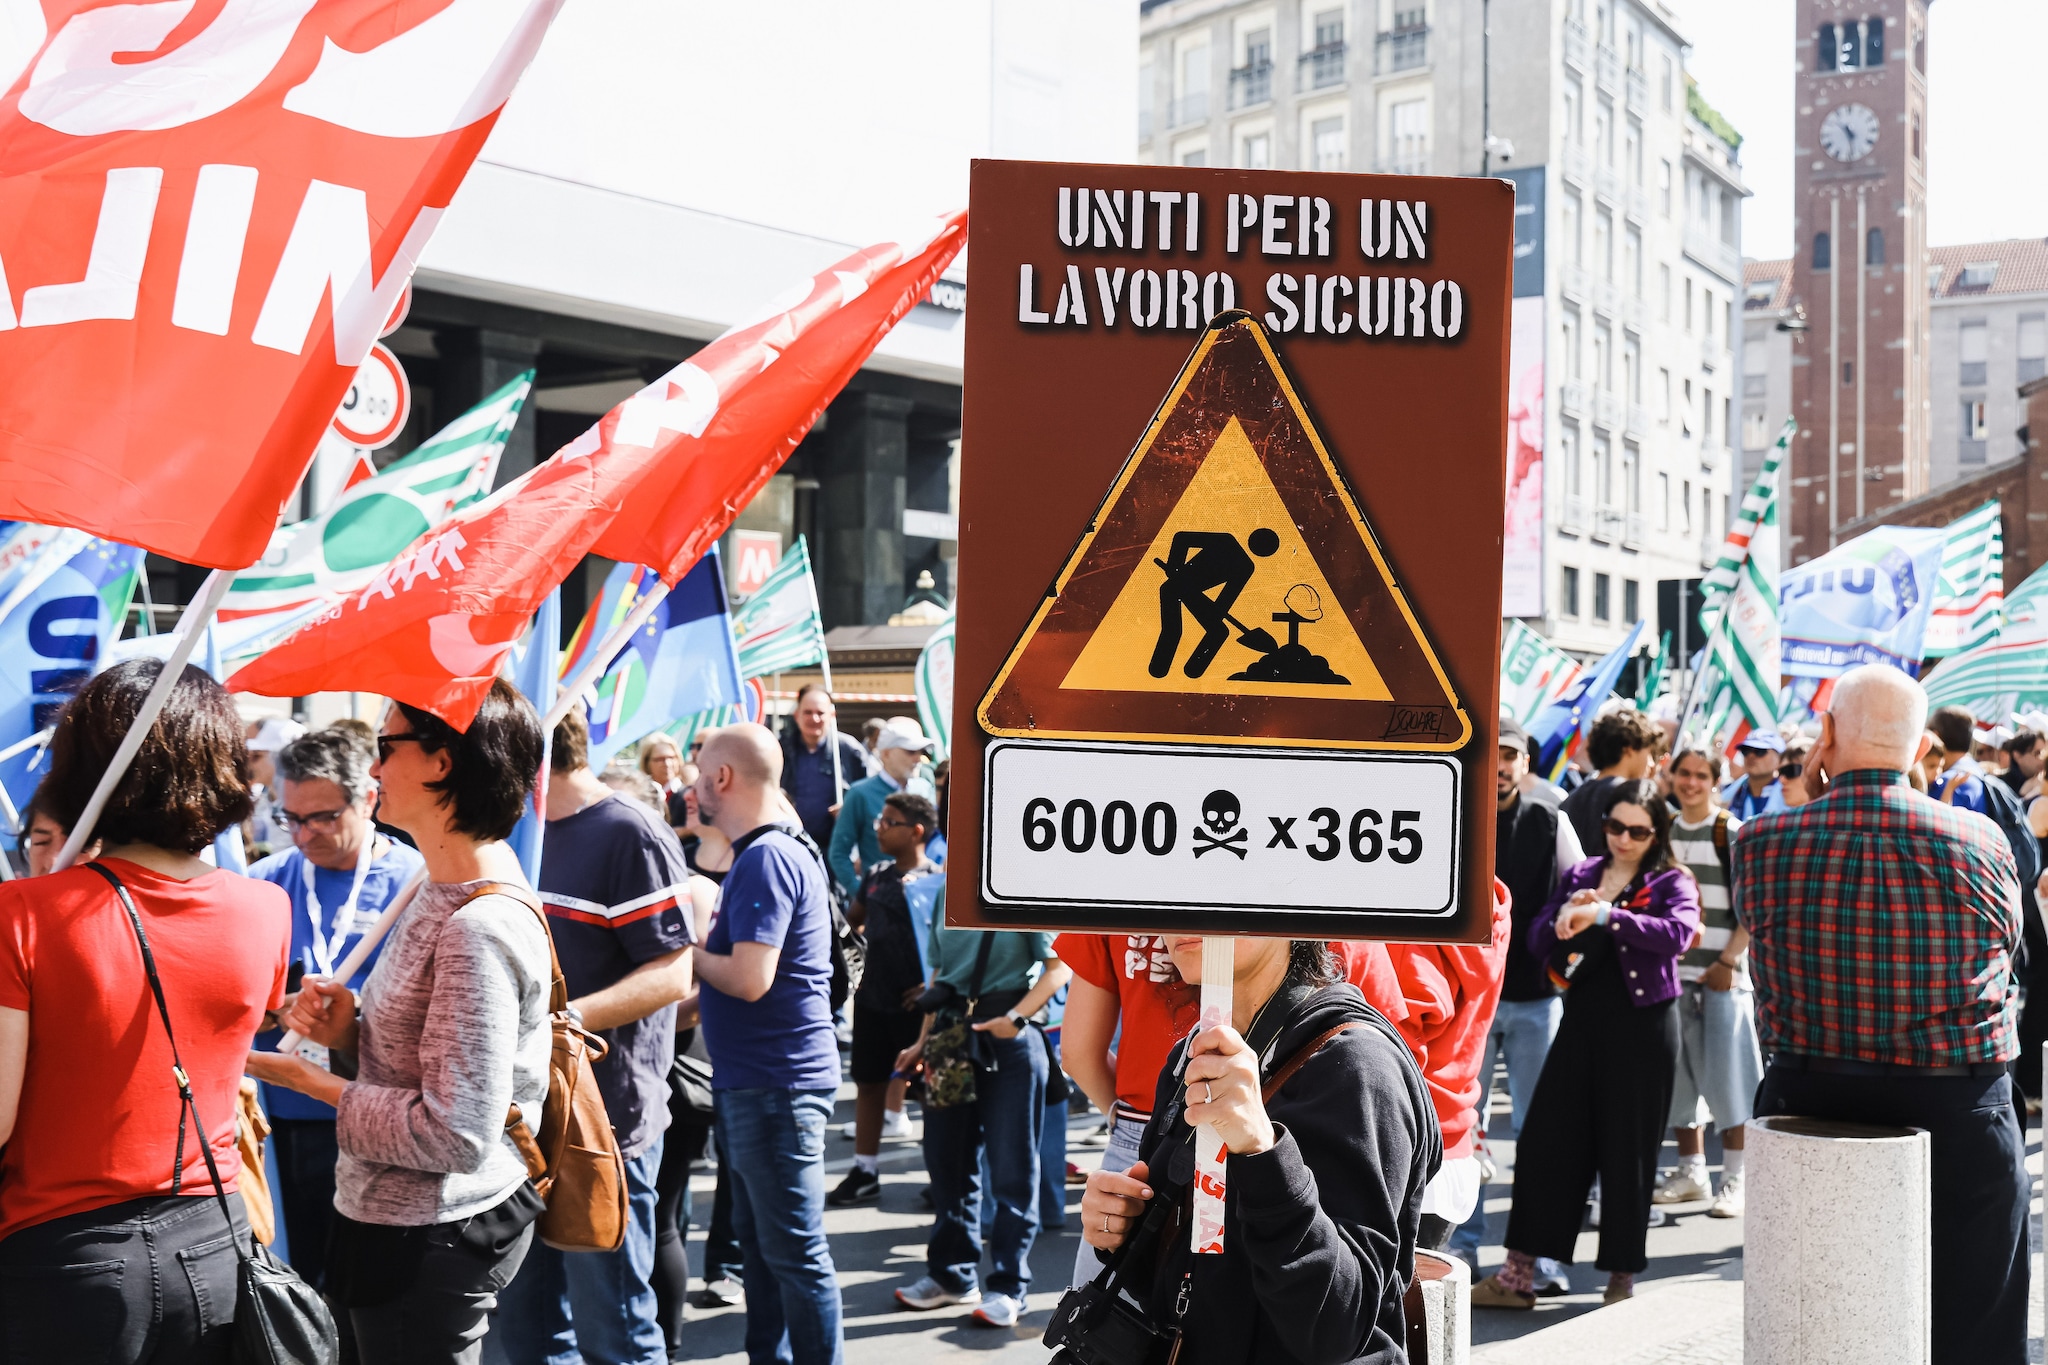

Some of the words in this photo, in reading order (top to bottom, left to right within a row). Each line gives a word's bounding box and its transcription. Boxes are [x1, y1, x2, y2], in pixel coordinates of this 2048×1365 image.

[1058, 186, 1199, 252] UNITI
[1226, 193, 1332, 257] PER
[1360, 198, 1427, 260] UN
[1018, 263, 1236, 330] LAVORO
[1265, 272, 1463, 338] SICURO
[738, 547, 775, 585] M
[1389, 709, 1438, 733] SQUARE
[1022, 797, 1178, 857] 6000
